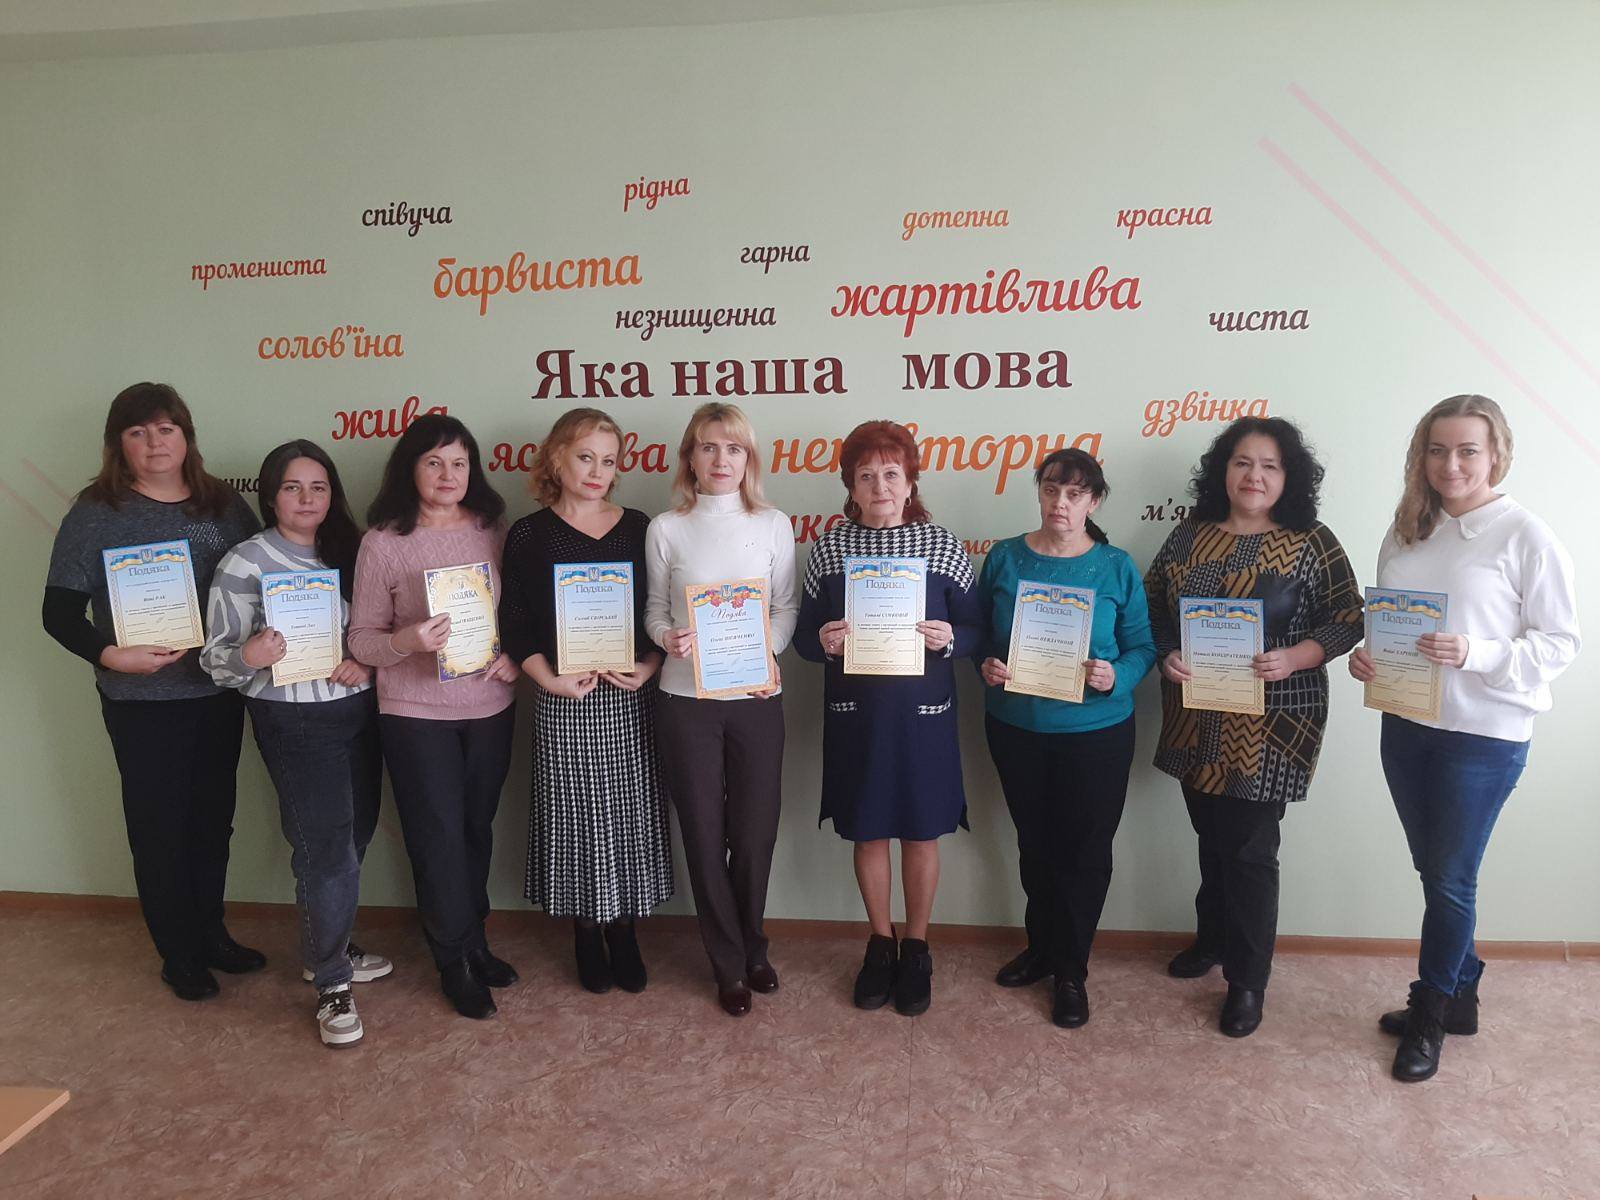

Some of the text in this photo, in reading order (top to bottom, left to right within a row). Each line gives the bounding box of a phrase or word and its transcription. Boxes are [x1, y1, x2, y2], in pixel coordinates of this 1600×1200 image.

[624, 176, 690, 212] рідна
[362, 201, 452, 237] співуча
[902, 209, 1009, 241] дотепна
[1117, 207, 1212, 239] красна
[192, 258, 327, 290] промениста
[741, 245, 810, 274] гарна
[434, 252, 643, 316] барвиста
[831, 266, 1141, 337] жартівлива
[616, 307, 776, 341] незнищенна
[1209, 310, 1309, 332] чиста
[531, 350, 1072, 399] Яка наша мова
[1141, 391, 1270, 437] дзвінка
[128, 564, 170, 577] Подяка
[865, 579, 905, 590] Подяка
[281, 592, 320, 603] Подяка
[575, 584, 613, 594] Подяка
[1035, 602, 1072, 616] Подяка
[1201, 618, 1242, 630] Подяка
[1382, 611, 1423, 625] Подяка
